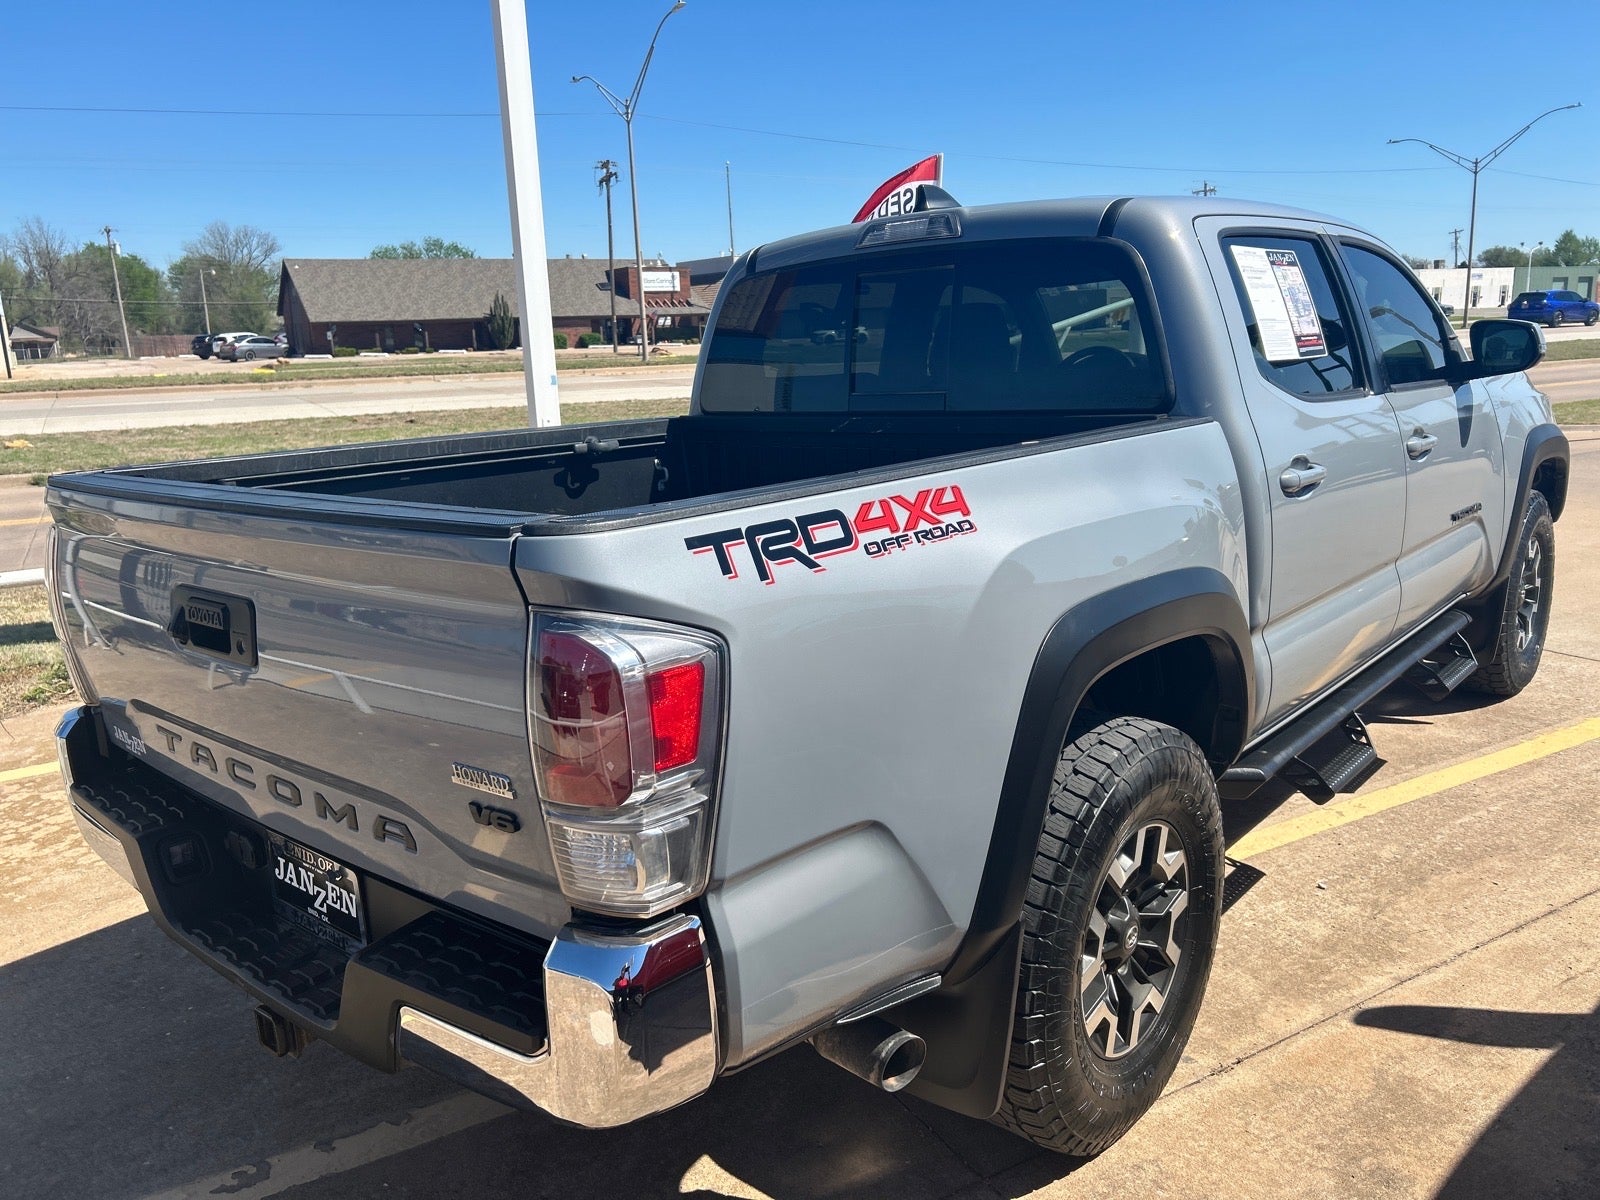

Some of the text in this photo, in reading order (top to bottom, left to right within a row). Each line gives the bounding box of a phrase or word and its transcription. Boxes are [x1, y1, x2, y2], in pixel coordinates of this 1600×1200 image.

[1269, 253, 1296, 265] JANZEN
[854, 485, 971, 534] 4X4
[684, 509, 860, 585] TRD
[863, 519, 977, 559] OFF ROAD
[188, 605, 224, 627] TOYOTA
[113, 725, 147, 754] JANZEN
[156, 724, 418, 854] TACOMA
[452, 763, 510, 791] HOWARD
[468, 800, 522, 833] V6
[275, 856, 357, 918] JANZEN
